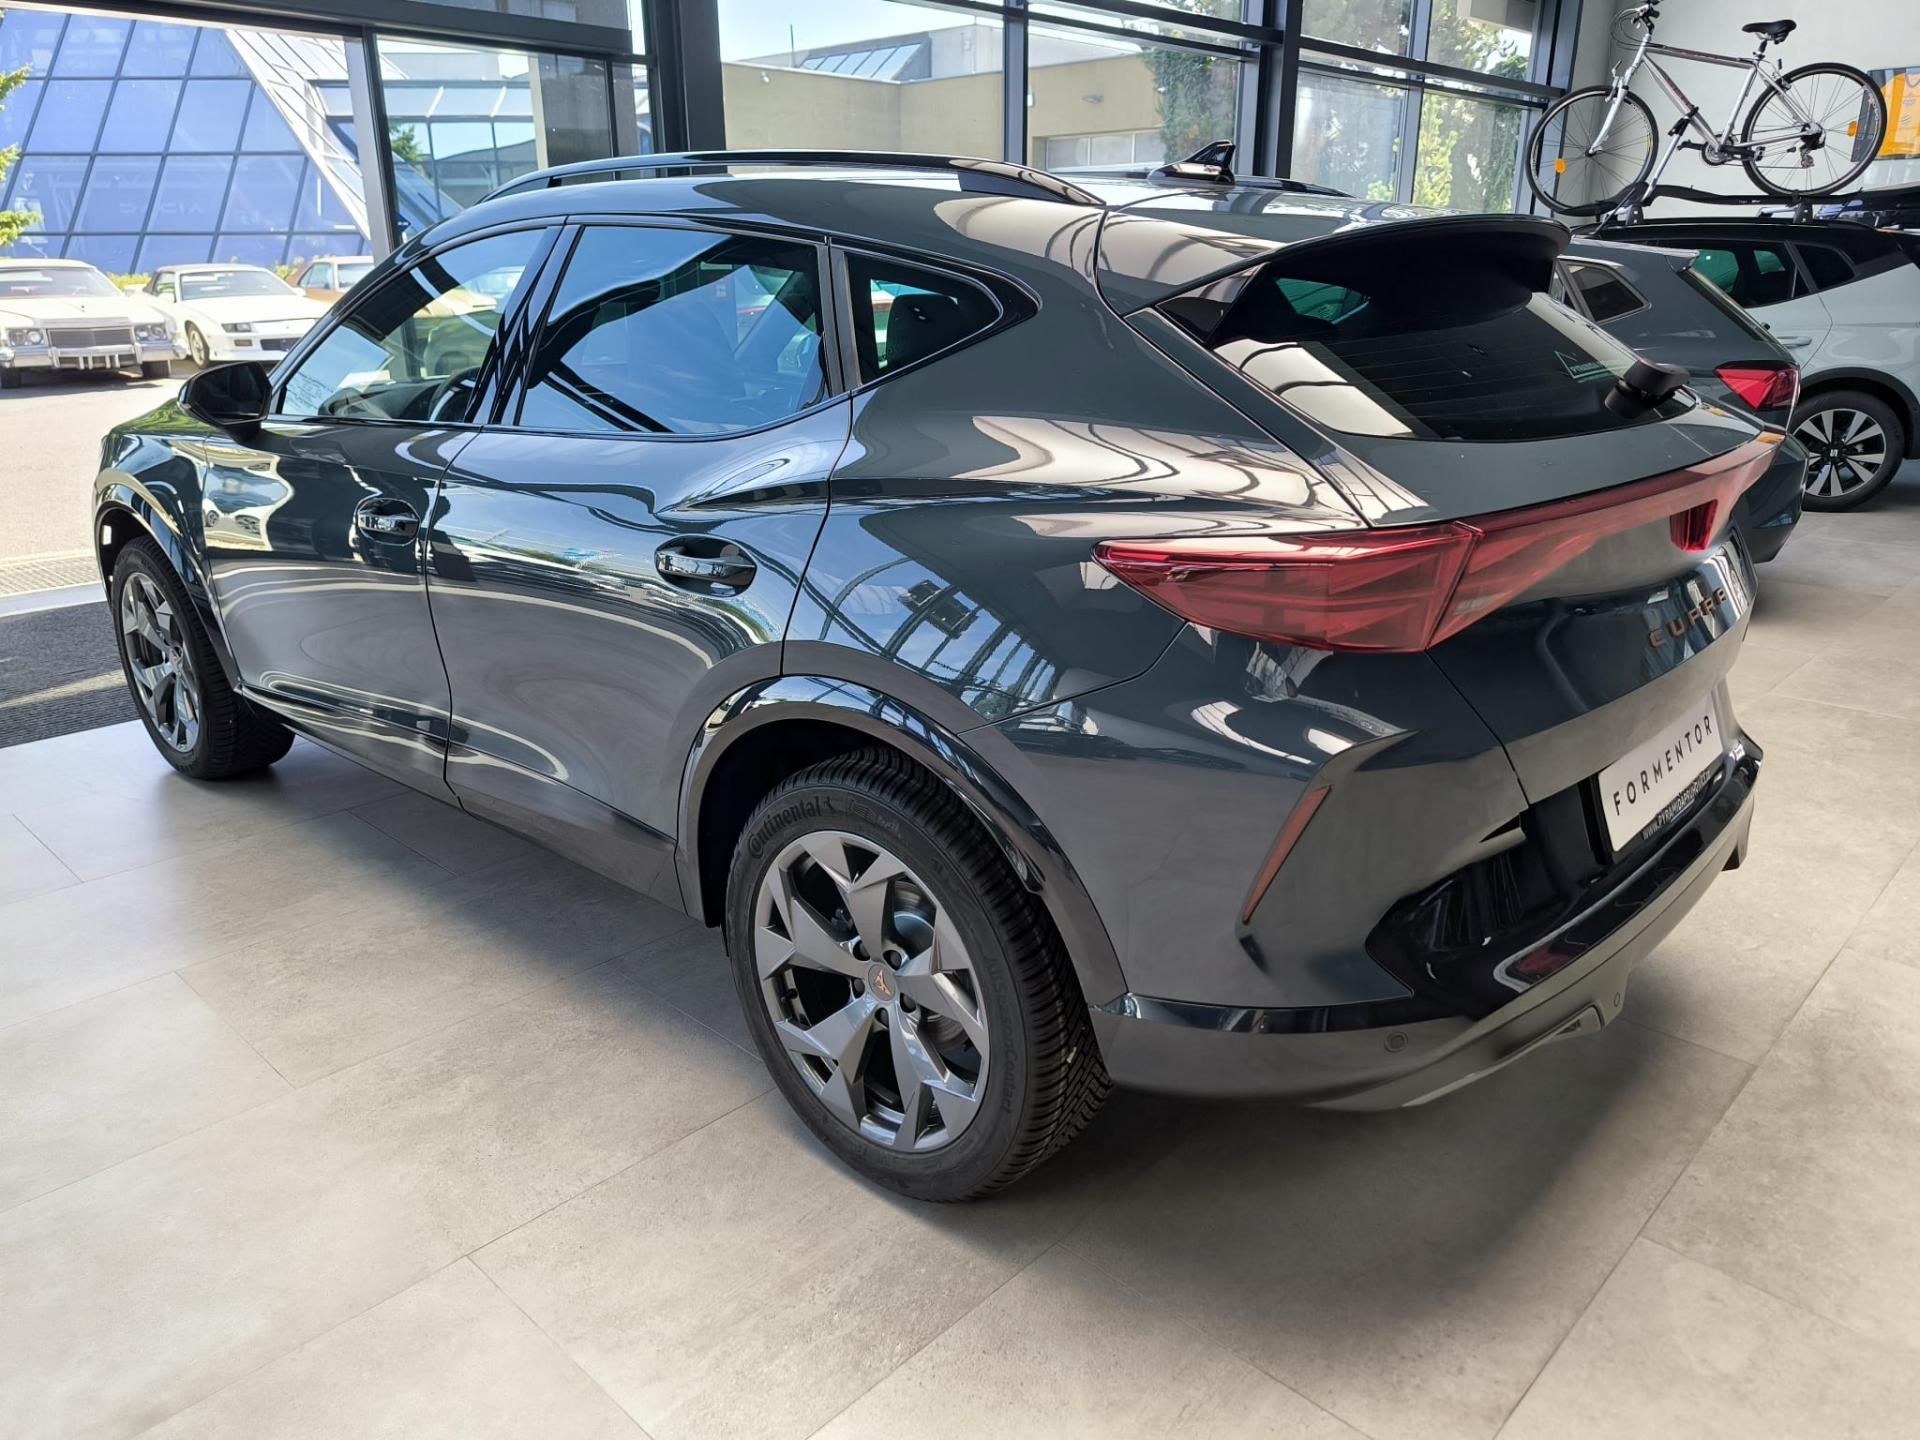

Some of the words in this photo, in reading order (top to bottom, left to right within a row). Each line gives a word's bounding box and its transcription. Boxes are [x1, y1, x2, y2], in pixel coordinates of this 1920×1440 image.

[119, 202, 208, 214] DCIA
[1649, 588, 1726, 648] CUPRA
[1613, 715, 1712, 816] FORMENTOR
[748, 795, 822, 857] Continental
